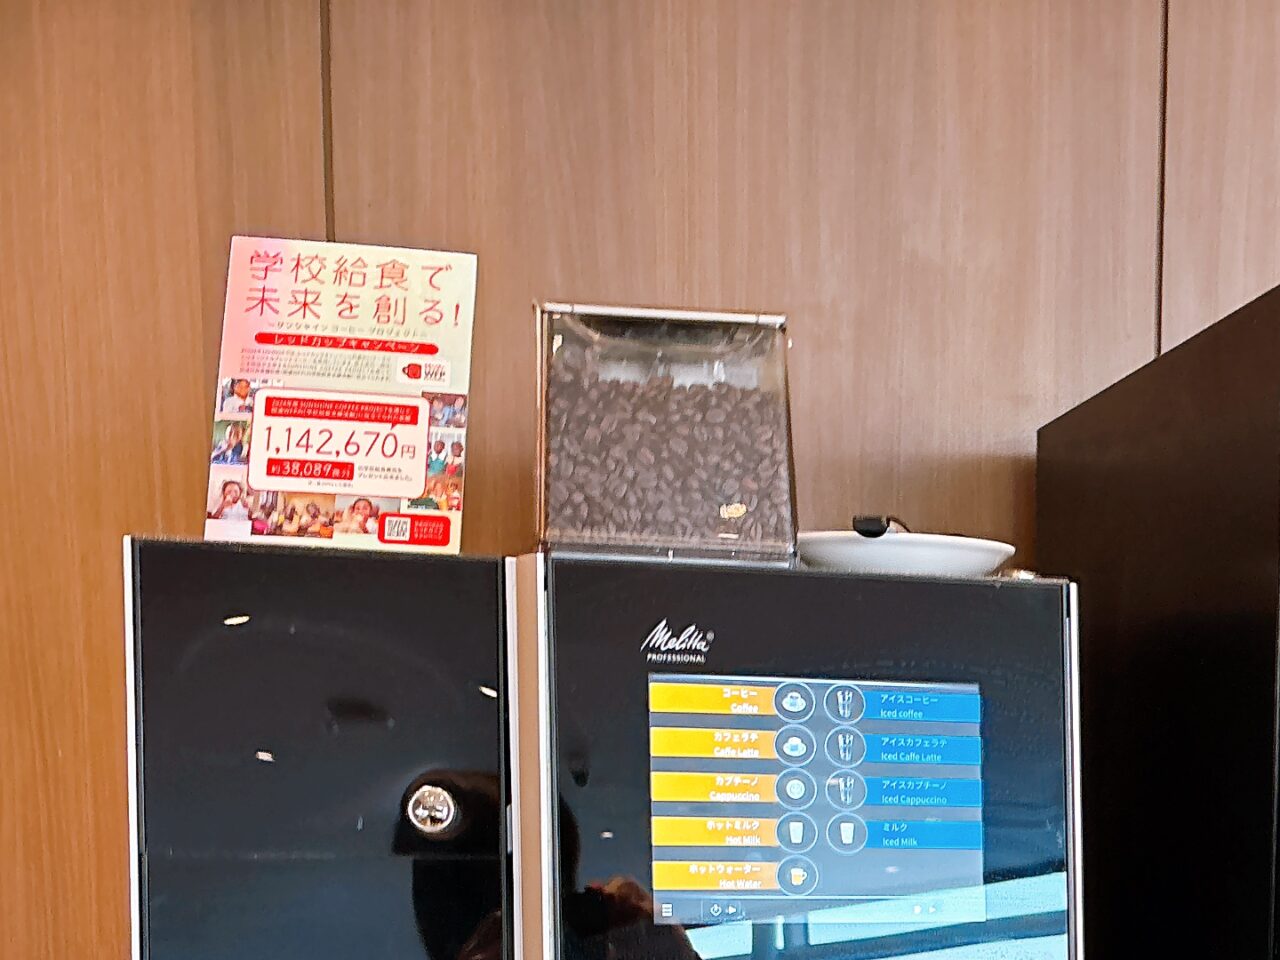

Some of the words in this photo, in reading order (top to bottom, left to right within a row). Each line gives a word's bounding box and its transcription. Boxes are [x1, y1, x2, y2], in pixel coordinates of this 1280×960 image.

[250, 250, 453, 292] 学校給食で
[273, 334, 421, 352] レッドカップキャンペーン
[265, 426, 416, 460] 1,142,670円
[640, 617, 710, 652] Melitta
[646, 653, 706, 664] PROFESSIONAL
[722, 688, 758, 698] コーヒー
[880, 694, 939, 704] アイスコーヒー
[730, 703, 759, 713] Coffee
[880, 709, 897, 718] Iced
[898, 709, 923, 719] coffee
[714, 732, 758, 742] カフェラテ
[881, 737, 948, 747] アイスカフェラテ
[881, 752, 898, 761] Iced
[899, 752, 920, 761] Caffe
[921, 753, 942, 762] Latte
[716, 776, 758, 786] カプチーノ
[882, 780, 947, 790] アイスカプチーノ
[882, 795, 899, 804] Iced
[900, 795, 947, 806] Cappuccino
[706, 820, 760, 830] ホットミルク
[883, 823, 907, 832] ミルク
[883, 837, 900, 846] Iced
[901, 837, 917, 846] Milk
[689, 864, 761, 874] ホットウォーター
